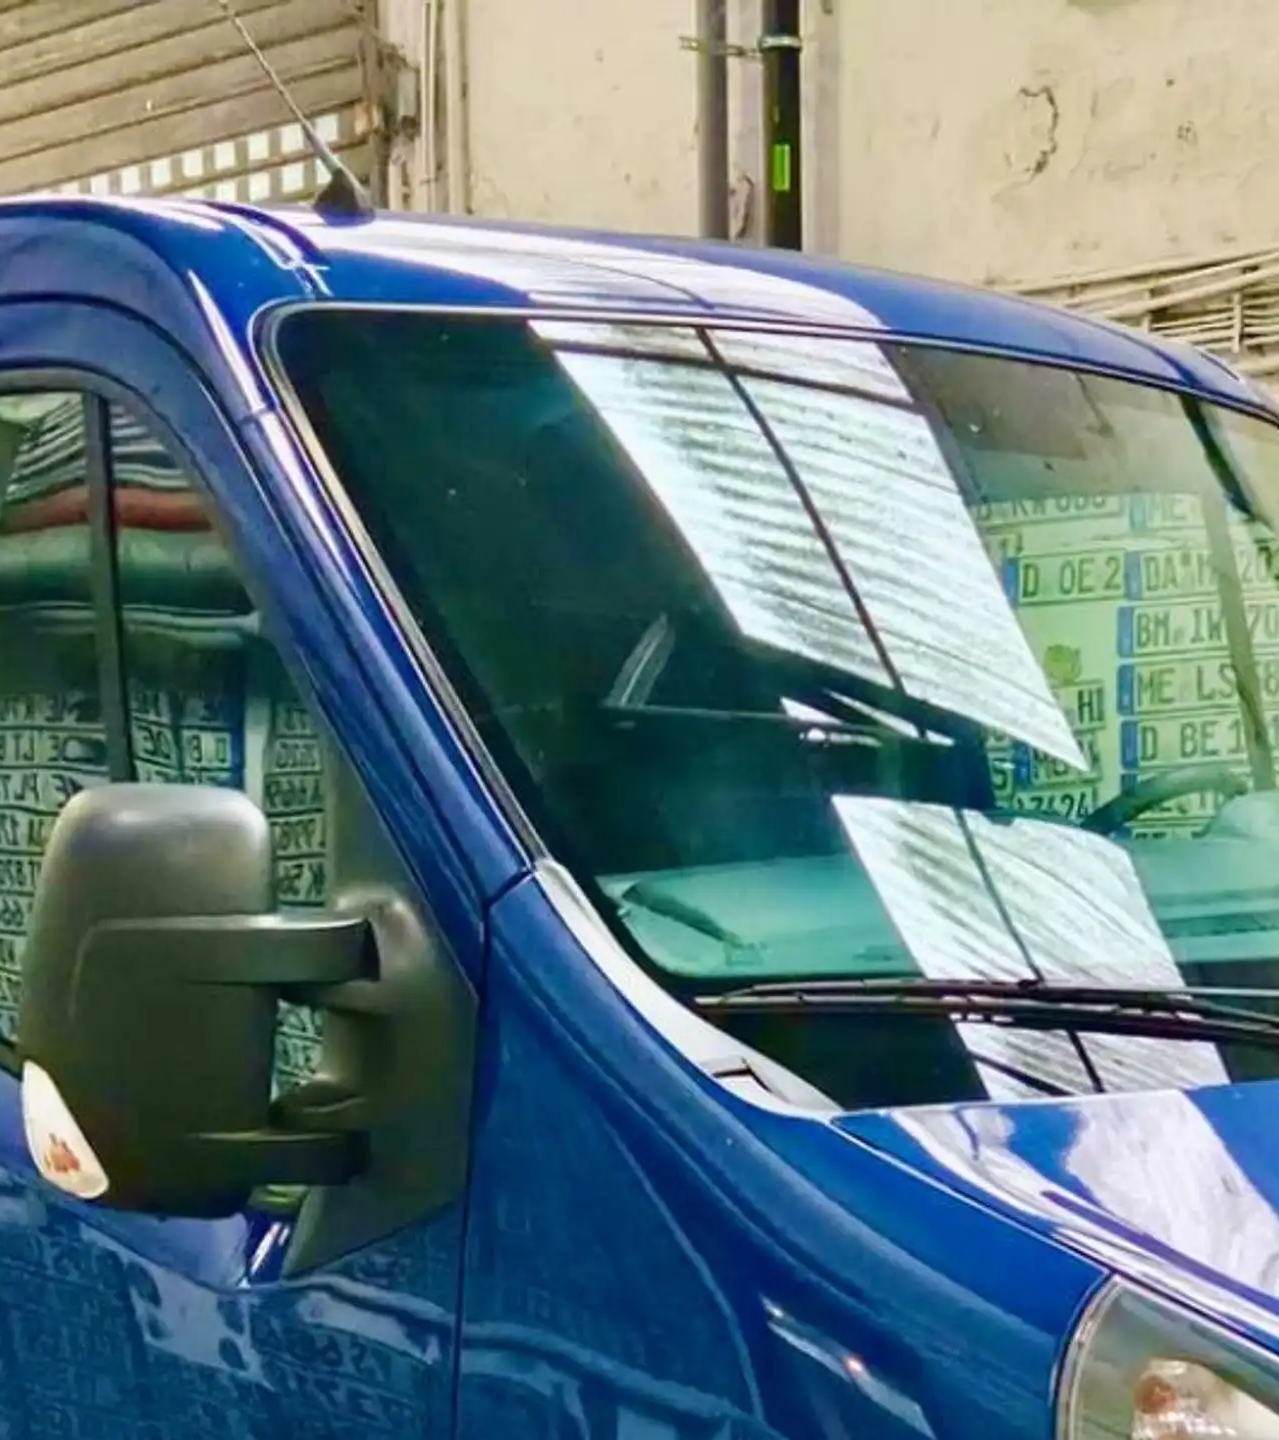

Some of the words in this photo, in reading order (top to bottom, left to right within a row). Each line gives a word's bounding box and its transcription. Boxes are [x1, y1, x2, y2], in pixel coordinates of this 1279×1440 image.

[1022, 564, 1039, 598] D
[1060, 557, 1094, 595] OE
[1103, 557, 1121, 590] 2
[1141, 726, 1158, 760] D
[1181, 720, 1219, 758] BE
